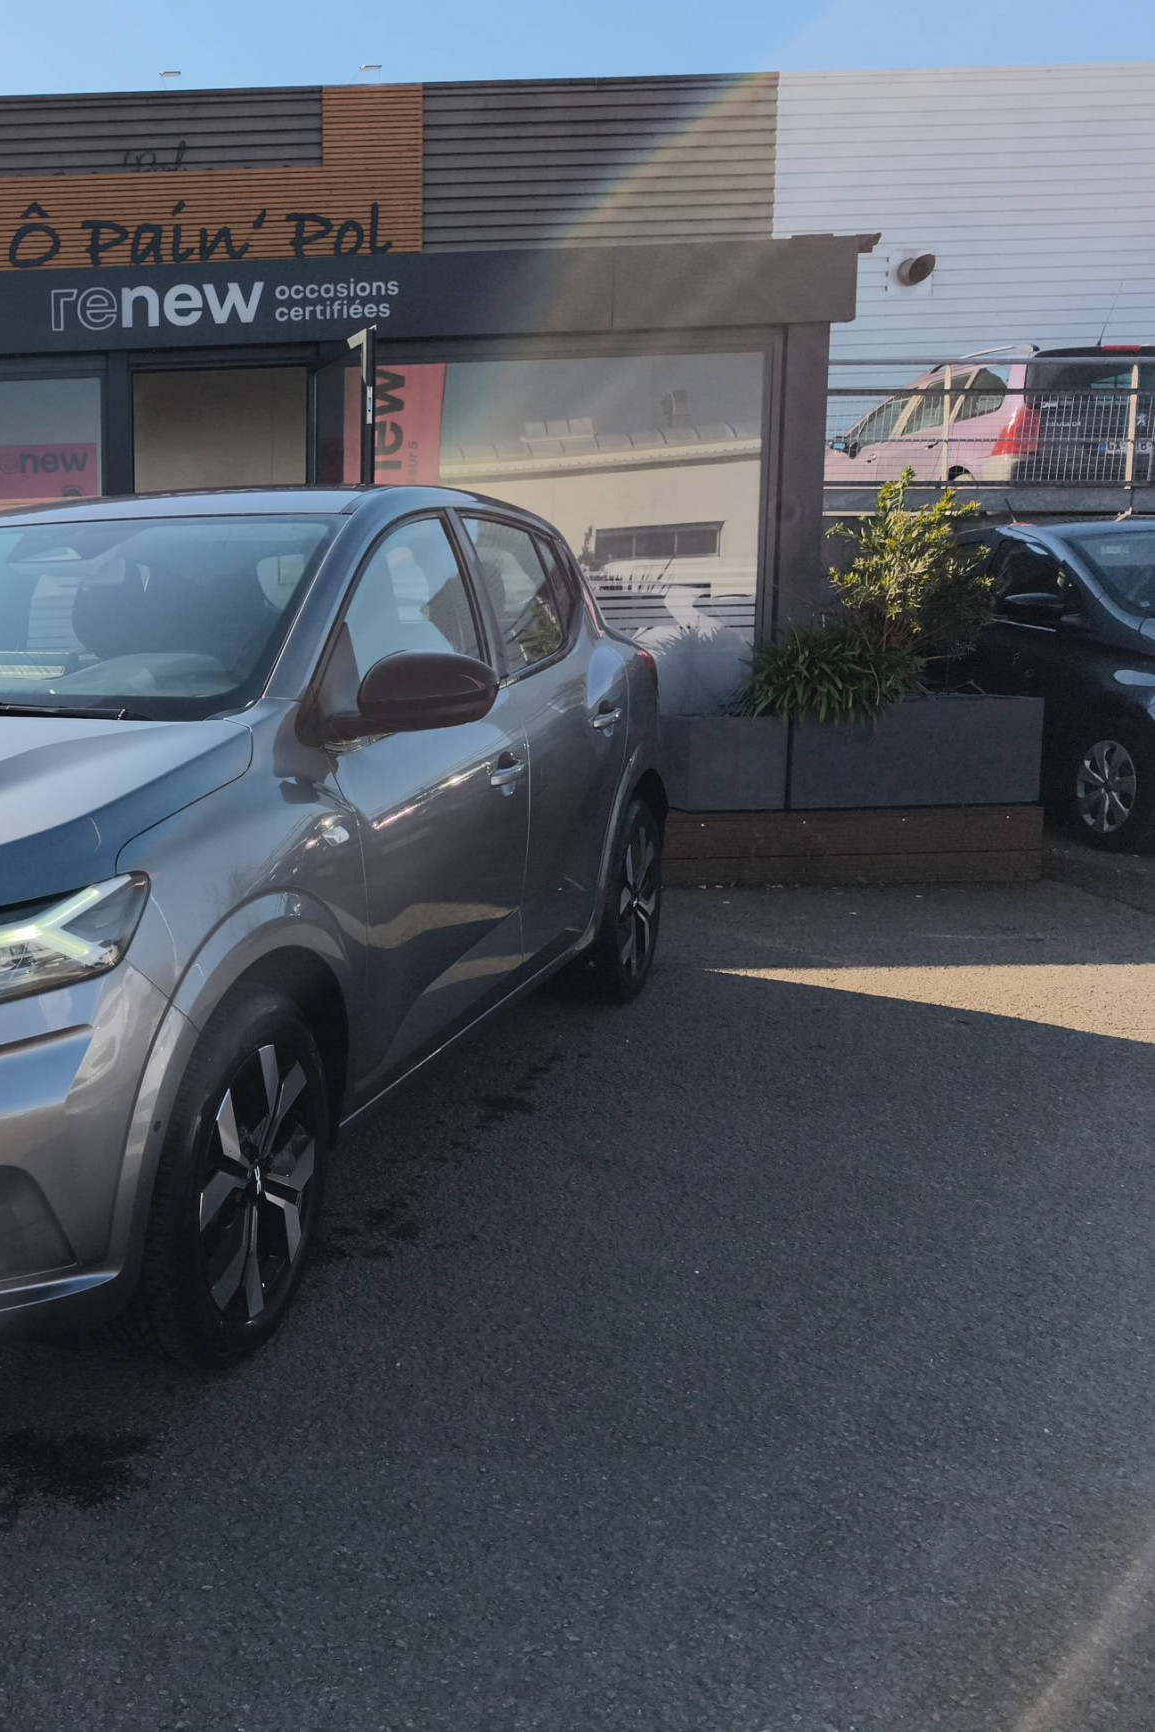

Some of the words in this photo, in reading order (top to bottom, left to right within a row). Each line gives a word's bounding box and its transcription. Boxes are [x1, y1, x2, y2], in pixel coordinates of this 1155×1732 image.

[9, 202, 61, 268] Ô
[286, 202, 393, 258] Pol
[50, 281, 264, 332] renew
[275, 278, 399, 300] occasions
[275, 299, 391, 322] certifiées
